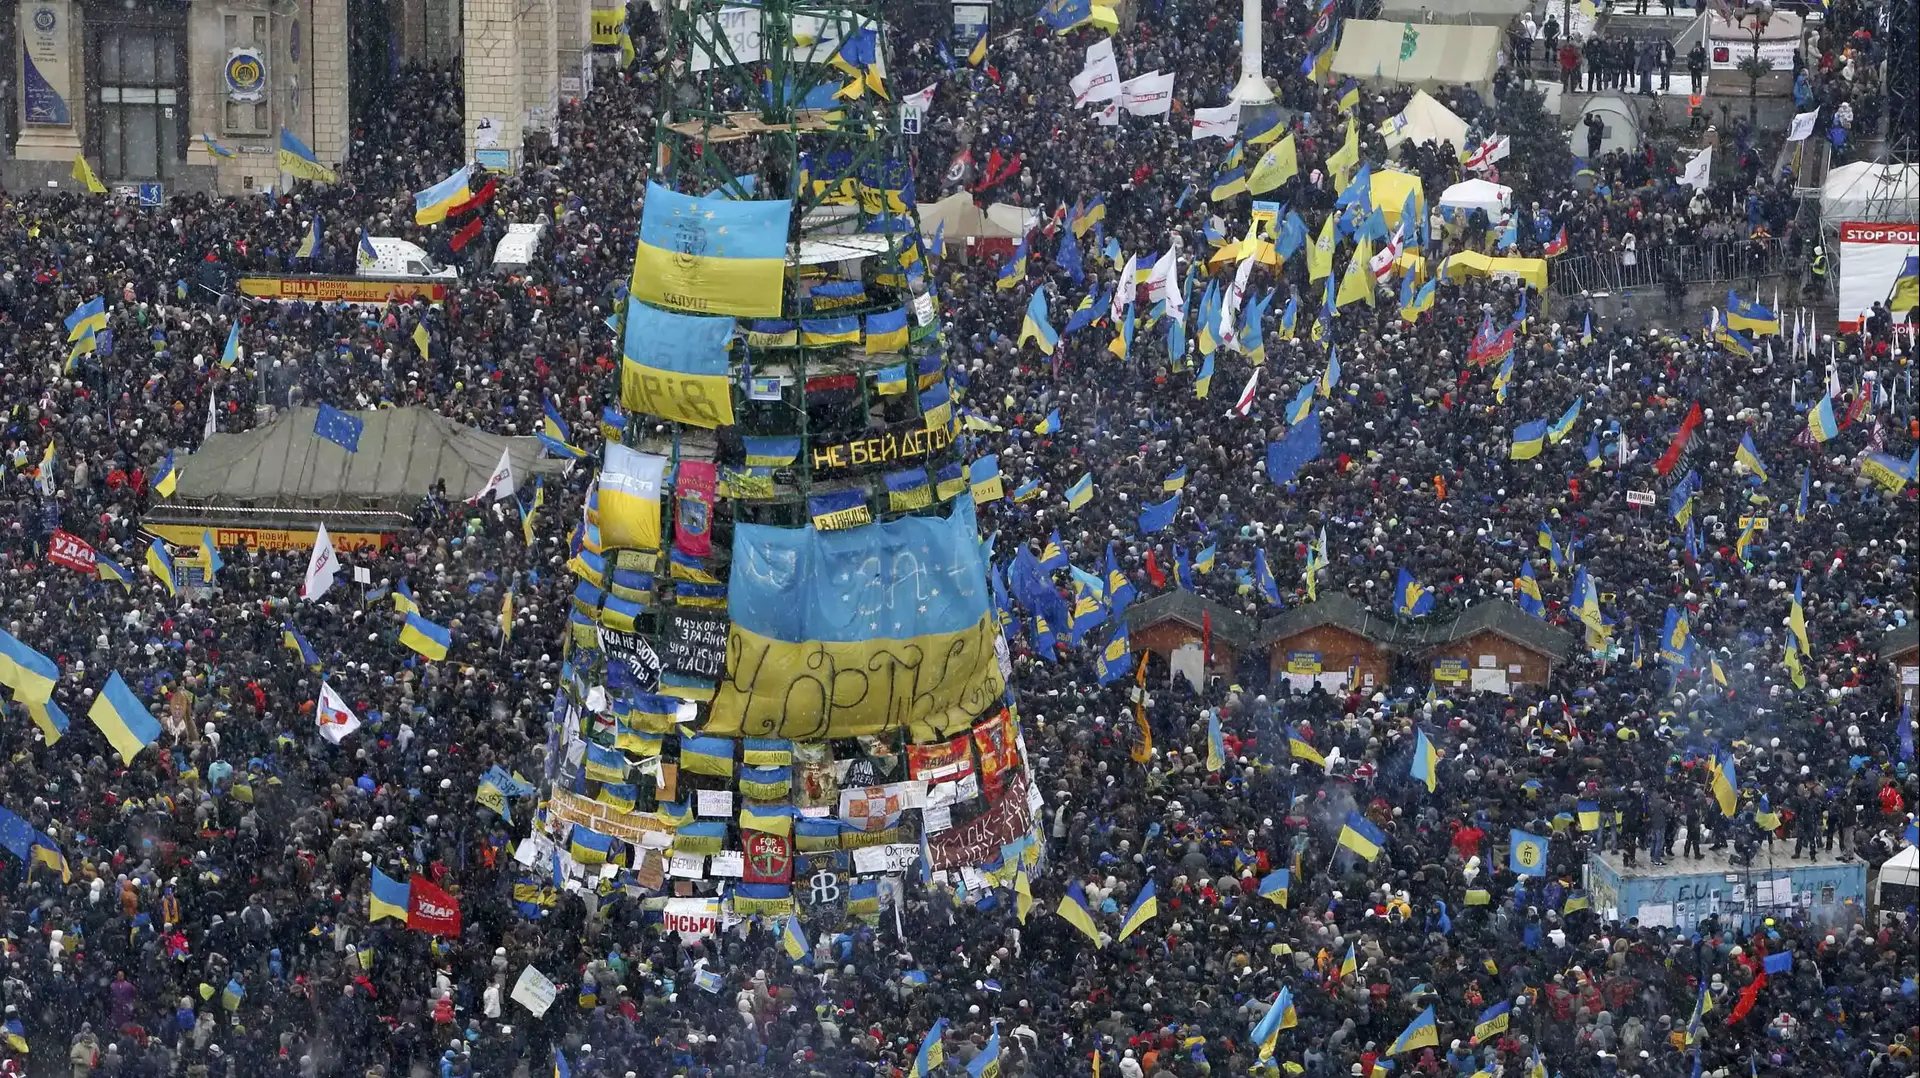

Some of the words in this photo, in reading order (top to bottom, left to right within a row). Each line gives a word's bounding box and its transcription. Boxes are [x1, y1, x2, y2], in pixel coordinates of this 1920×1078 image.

[1847, 229, 1884, 240] STOP
[282, 282, 317, 293] BILLA
[319, 289, 379, 298] СУПЕРМАРКЕТ
[813, 444, 847, 470] НЕ
[849, 432, 898, 465] БЕЙ
[1628, 492, 1654, 503] ВОЛИНЬ
[819, 507, 871, 530] ВІННИЦЯ
[1740, 519, 1762, 527] УМНЬ
[259, 533, 290, 542] НОВИЙ
[669, 641, 726, 663] УКРАЇНСЬОЇ
[760, 837, 776, 846] FOR
[755, 845, 783, 855] PEACE
[418, 901, 454, 917] УДАР
